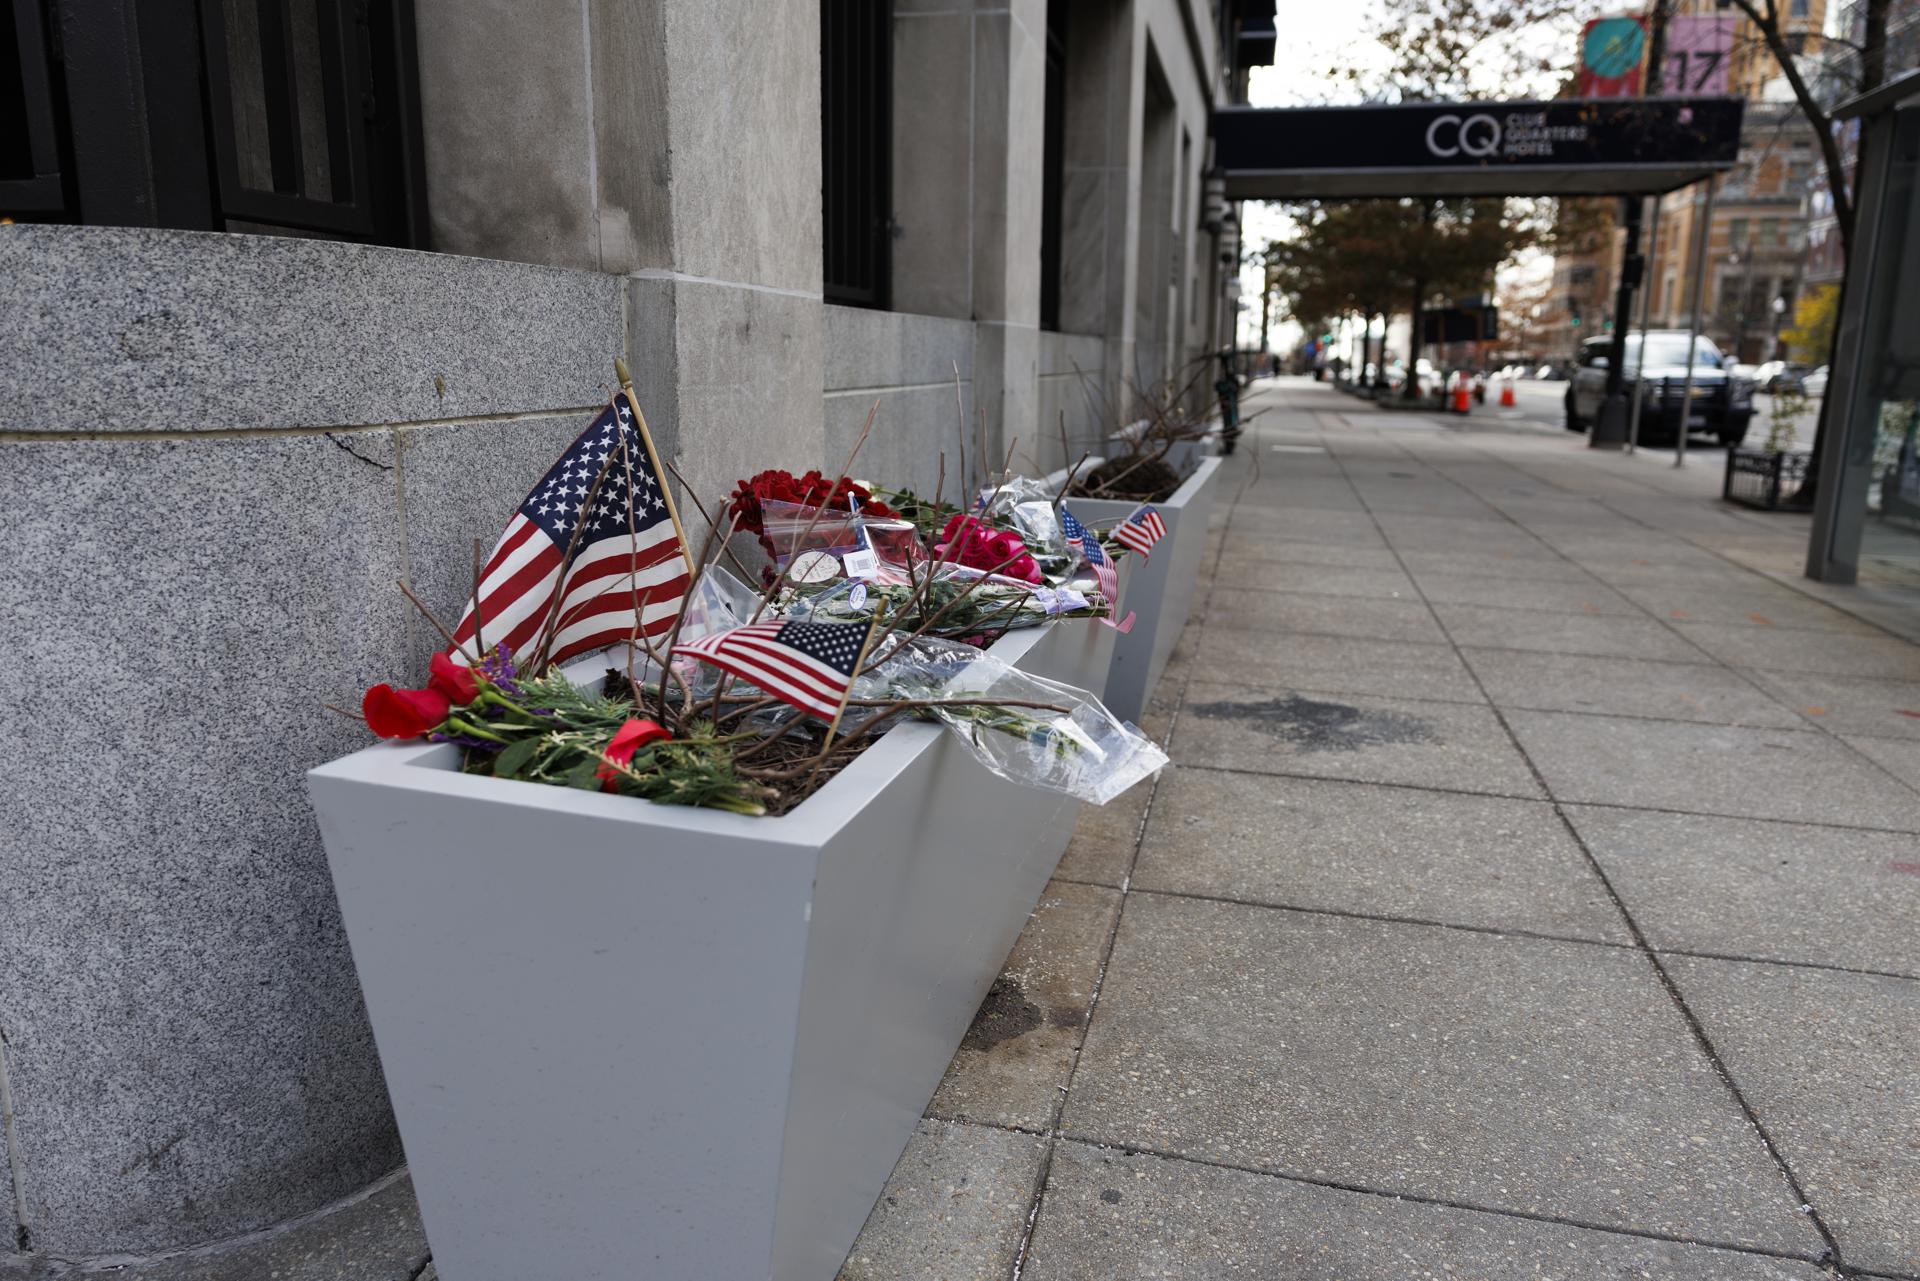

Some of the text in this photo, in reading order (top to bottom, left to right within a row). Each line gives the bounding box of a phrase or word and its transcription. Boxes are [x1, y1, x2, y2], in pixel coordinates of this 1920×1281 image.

[1672, 51, 1725, 92] 17
[1507, 113, 1547, 126] CLUB
[1426, 114, 1503, 156] CQ
[1506, 126, 1588, 141] QUARTERS
[1505, 141, 1553, 155] HOTEL
